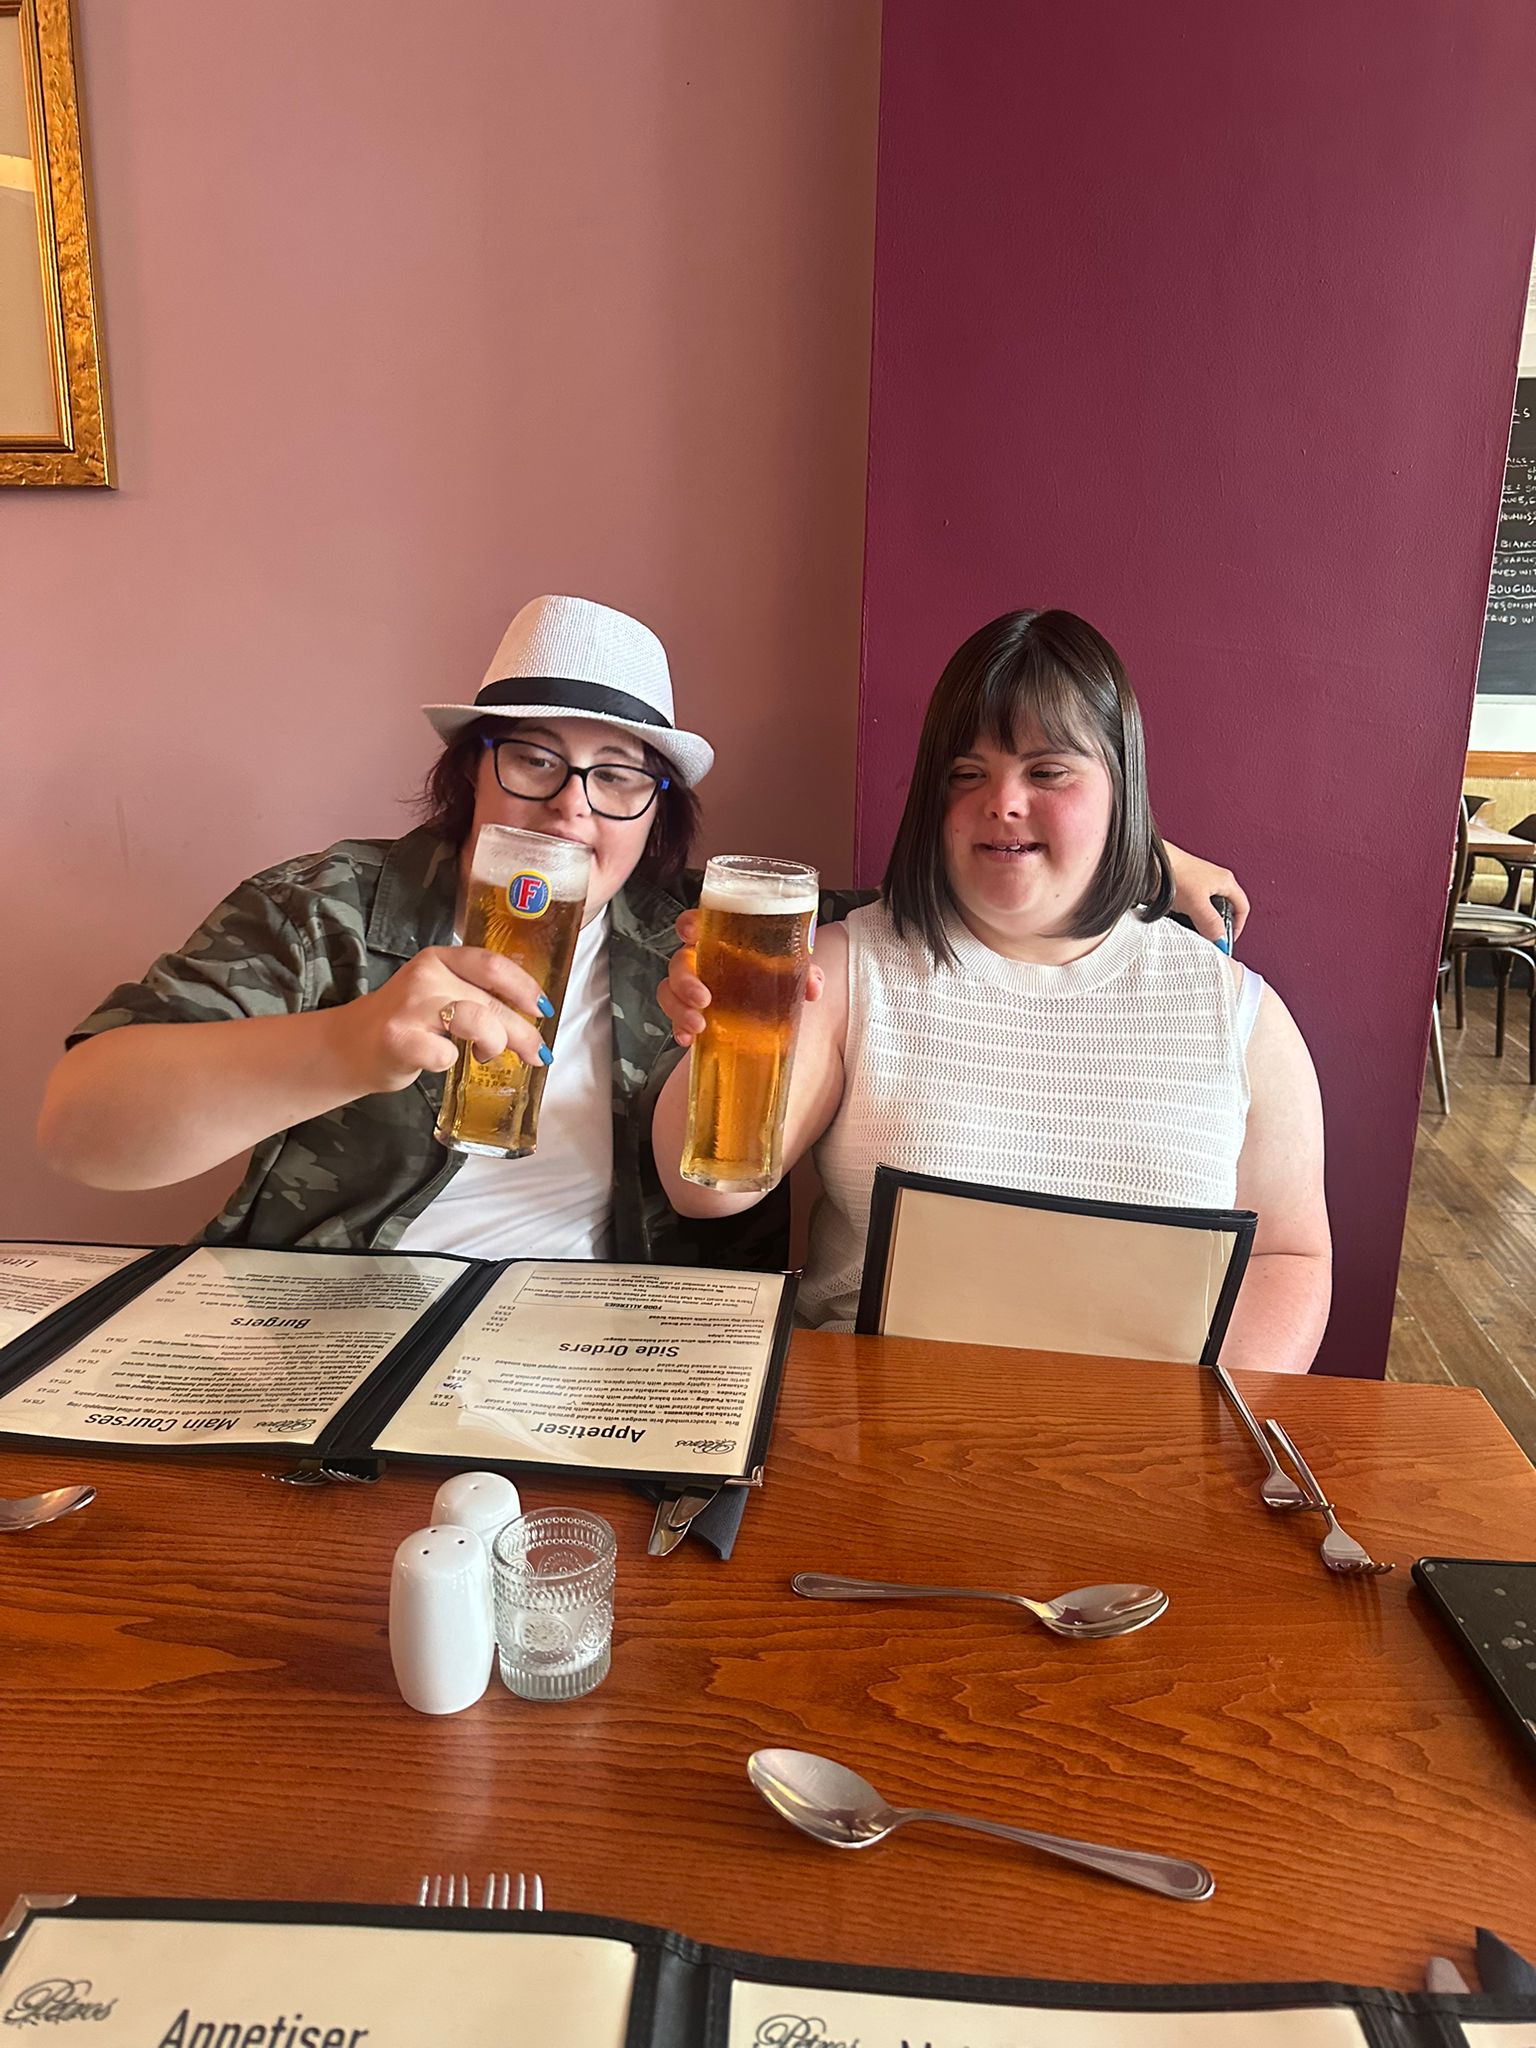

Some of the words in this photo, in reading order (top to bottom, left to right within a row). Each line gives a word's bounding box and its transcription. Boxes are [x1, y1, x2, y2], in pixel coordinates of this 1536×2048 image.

[516, 877, 542, 910] F
[231, 1317, 311, 1330] Burgers
[558, 1342, 628, 1356] Orders
[635, 1344, 680, 1357] Side
[85, 1414, 178, 1432] Courses
[182, 1417, 240, 1432] Main
[530, 1422, 646, 1444] Appetiser
[675, 1438, 737, 1454] Petros
[4, 1978, 118, 2029] Petros
[158, 2008, 369, 2048] Appetiser
